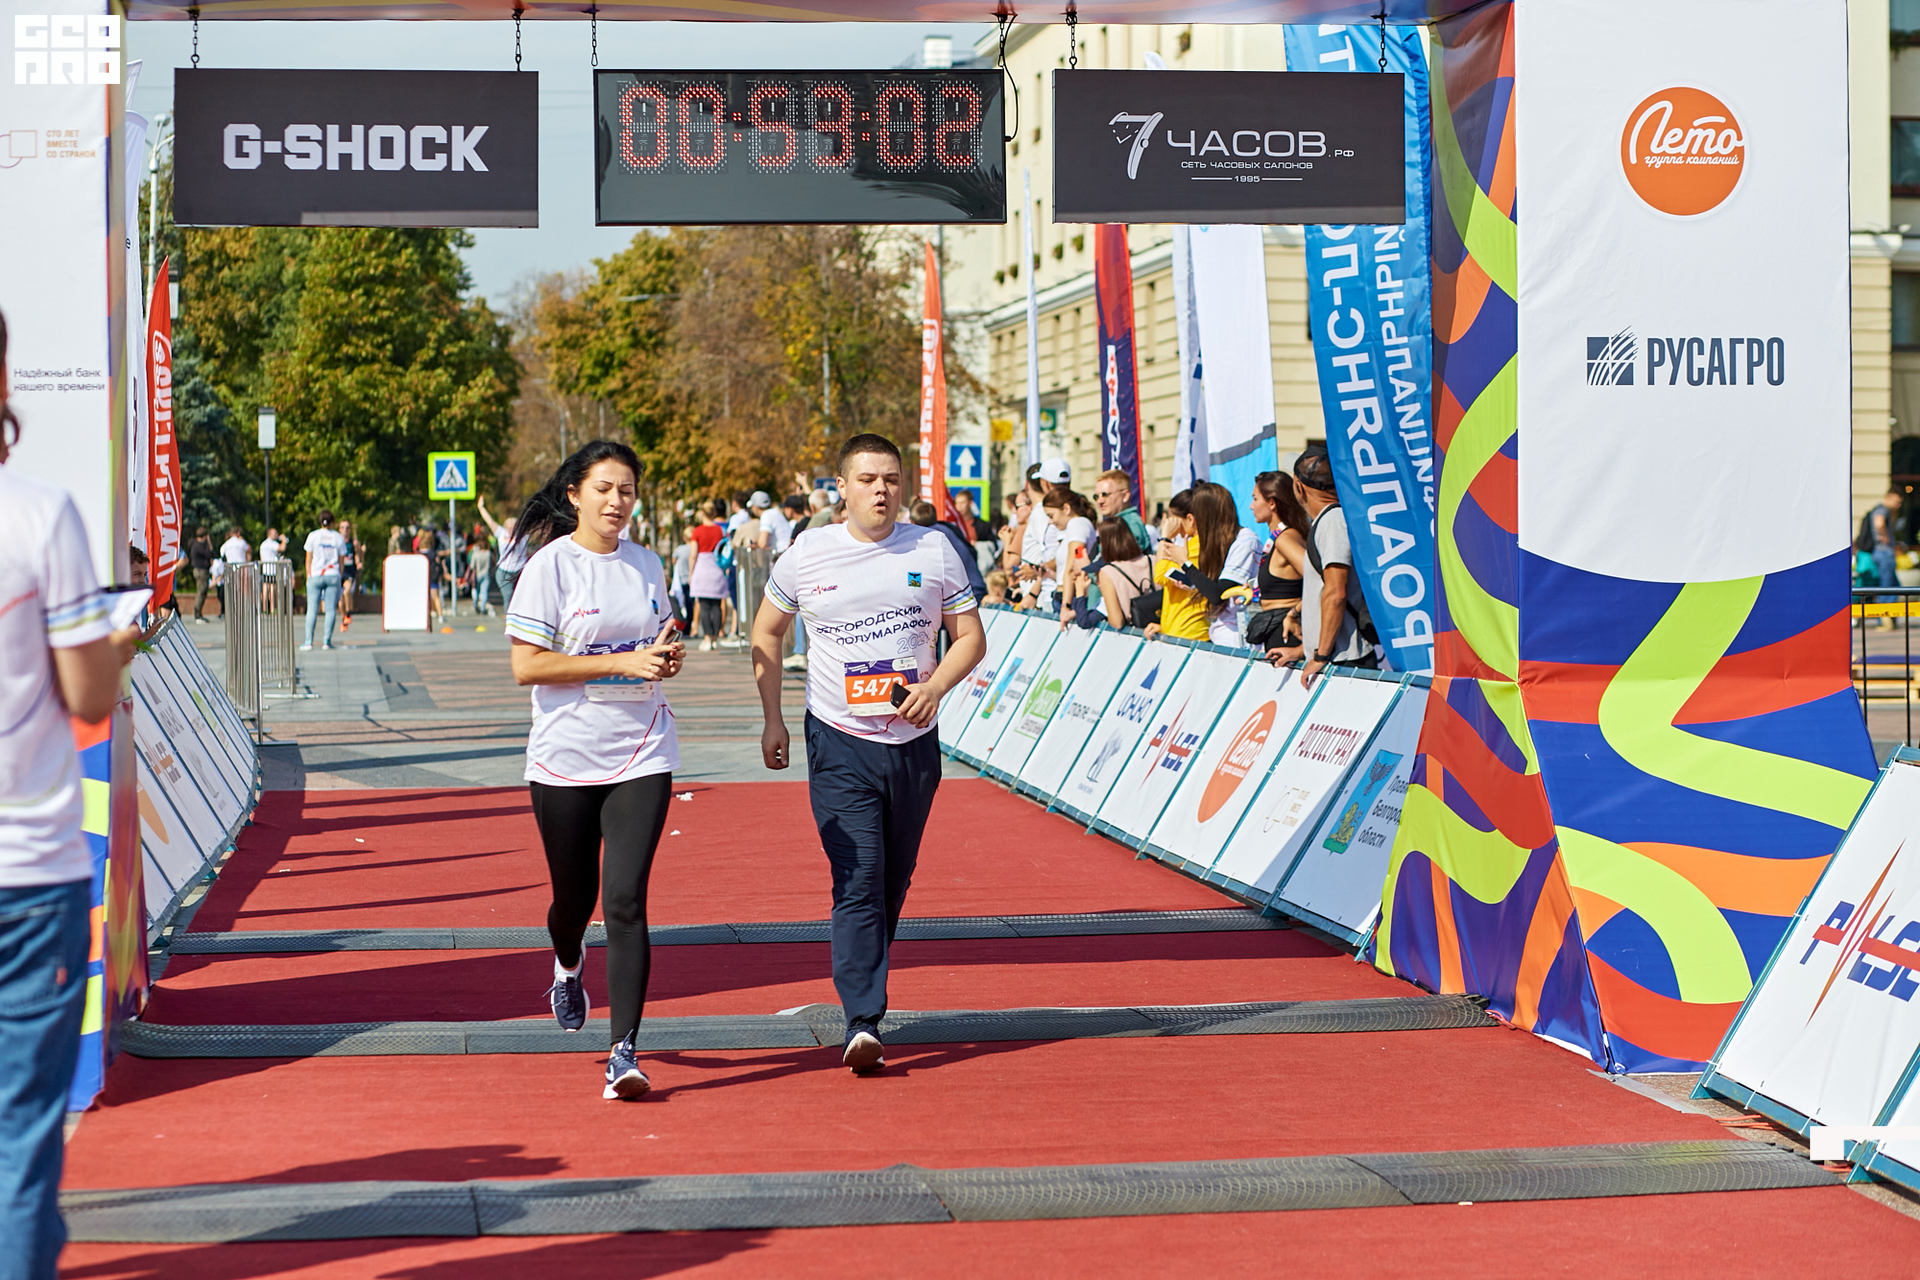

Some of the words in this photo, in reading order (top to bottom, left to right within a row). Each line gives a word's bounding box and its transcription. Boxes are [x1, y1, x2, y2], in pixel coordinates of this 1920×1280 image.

[46, 130, 61, 138] СТО
[64, 130, 79, 138] ЛЕТ
[1629, 100, 1745, 164] Лето
[46, 140, 78, 148] ВМЕСТЕ
[223, 123, 489, 171] G-SHOCK
[1108, 111, 1164, 180] 7
[46, 150, 57, 158] СО
[60, 149, 96, 158] СТРАНОЙ
[1181, 161, 1207, 169] СЕТЬ
[1210, 161, 1260, 169] ЧАСОВЫХ
[1644, 155, 1684, 169] группа
[1685, 154, 1740, 165] компаний
[1646, 336, 1785, 386] РУСАГРО
[14, 368, 72, 379] Надёжный
[76, 367, 101, 378] банк
[14, 383, 54, 391] нашего
[57, 383, 105, 392] времени
